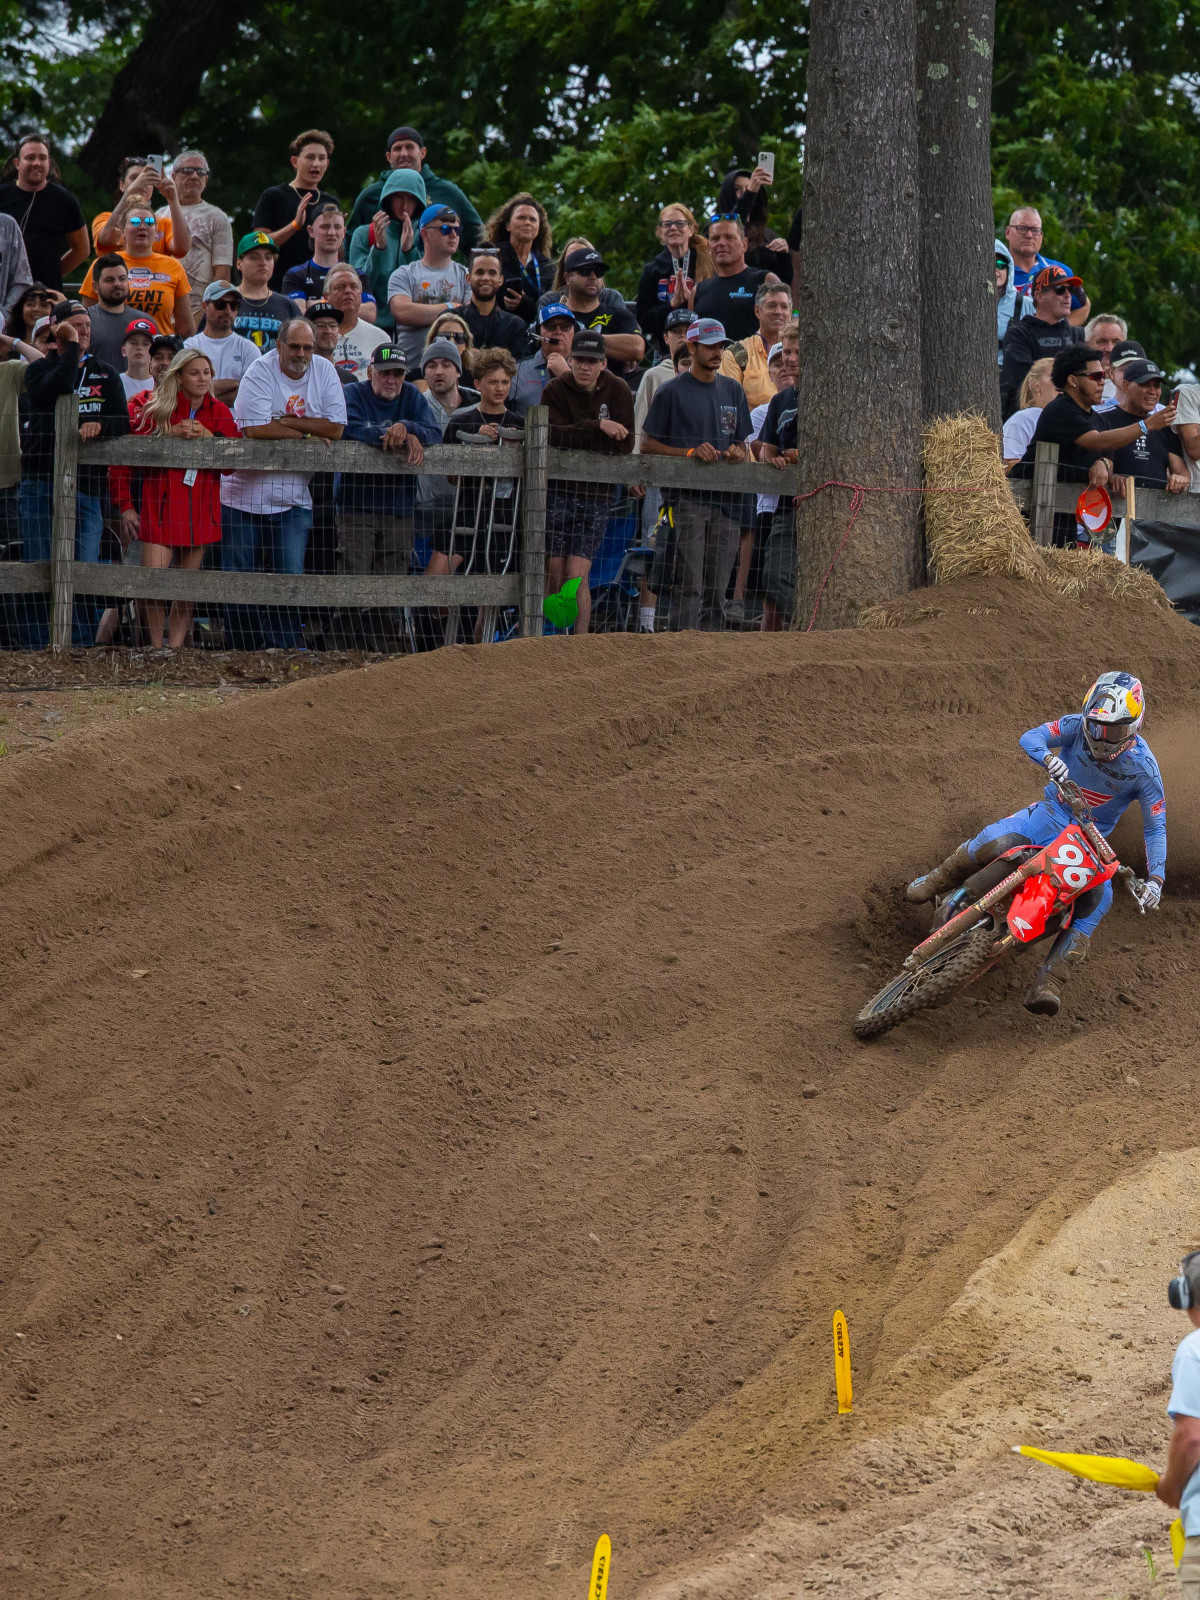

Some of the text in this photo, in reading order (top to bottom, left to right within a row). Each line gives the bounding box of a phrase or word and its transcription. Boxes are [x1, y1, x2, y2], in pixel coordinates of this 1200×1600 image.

[127, 289, 164, 303] VENT
[127, 303, 163, 316] TAFF
[79, 403, 102, 413] ZUKI
[1051, 844, 1096, 889] 96
[594, 1556, 606, 1600] CERBIS
